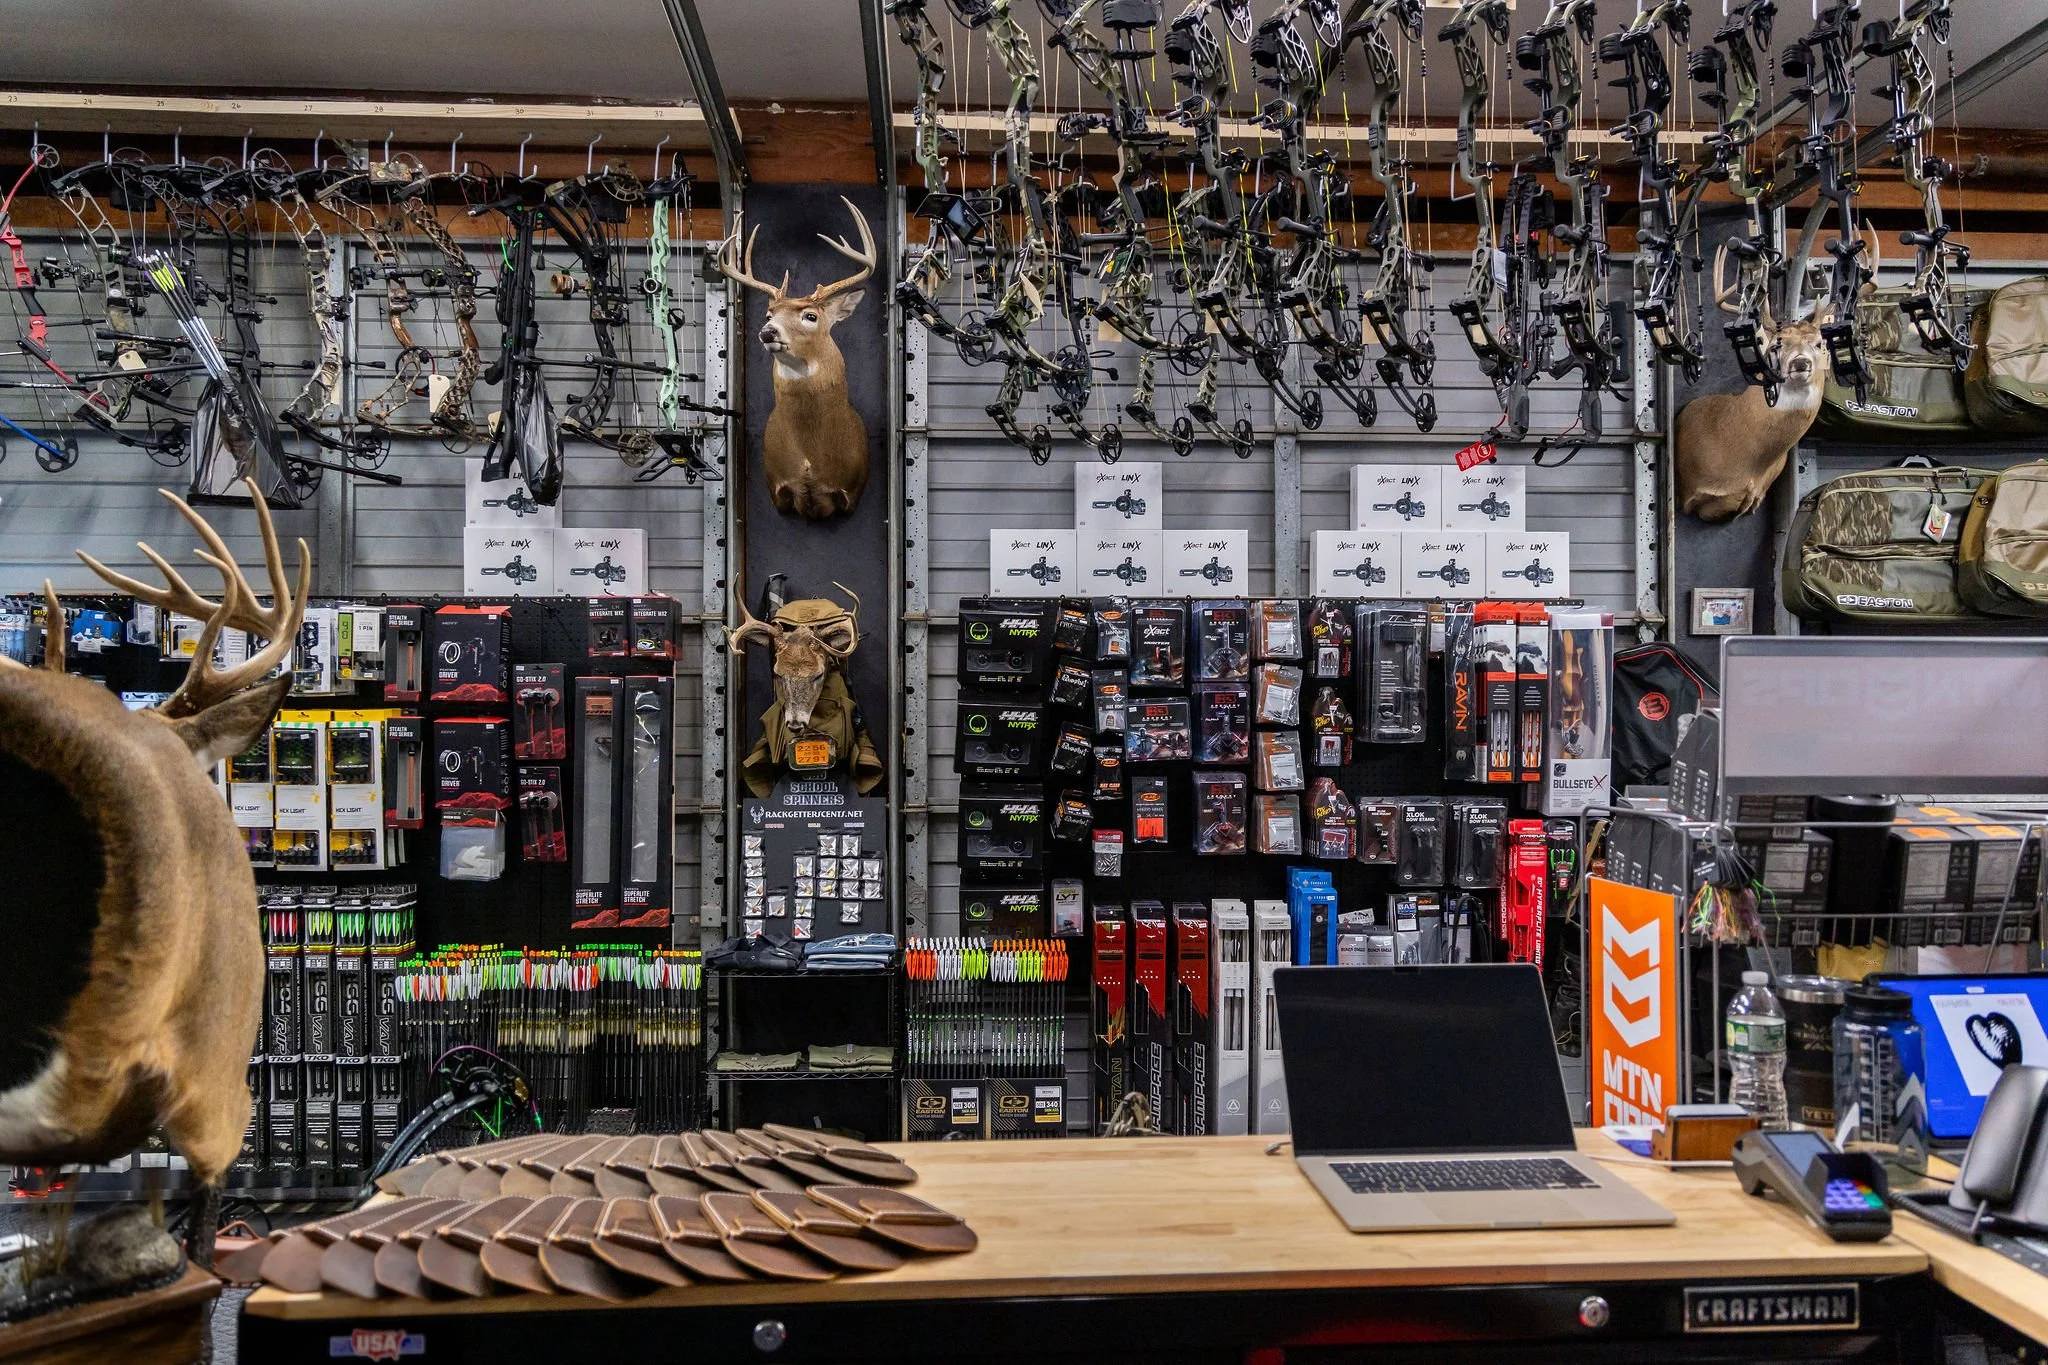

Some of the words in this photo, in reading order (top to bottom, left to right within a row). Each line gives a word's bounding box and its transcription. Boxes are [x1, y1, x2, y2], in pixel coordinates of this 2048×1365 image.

[1858, 596, 1914, 608] EASTON
[1000, 619, 1039, 628] HHA
[1009, 630, 1038, 638] NYTRX
[1144, 625, 1170, 638] eXact
[1456, 672, 1467, 732] RAVIN
[998, 711, 1037, 721] HHA
[1008, 721, 1037, 731] NYTRX
[790, 782, 838, 792] SCHOOL
[1553, 779, 1593, 789] BULLSEYE
[1591, 775, 1608, 794] X
[783, 795, 844, 805] SPINNERS
[765, 810, 864, 818] RACKGETTERSCENTS.NET
[1000, 804, 1040, 814] HHA
[1010, 815, 1038, 823] NYTRX
[1000, 895, 1039, 905] HHA
[1010, 905, 1038, 913] NYTRX
[276, 1017, 287, 1055] RIP
[313, 1016, 322, 1054] VAP
[344, 1018, 353, 1056] VAP
[380, 1018, 389, 1056] VAP
[1604, 1049, 1661, 1114] MTN
[1698, 1296, 1848, 1322] CRAFTSMAN
[358, 1333, 397, 1353] USA
